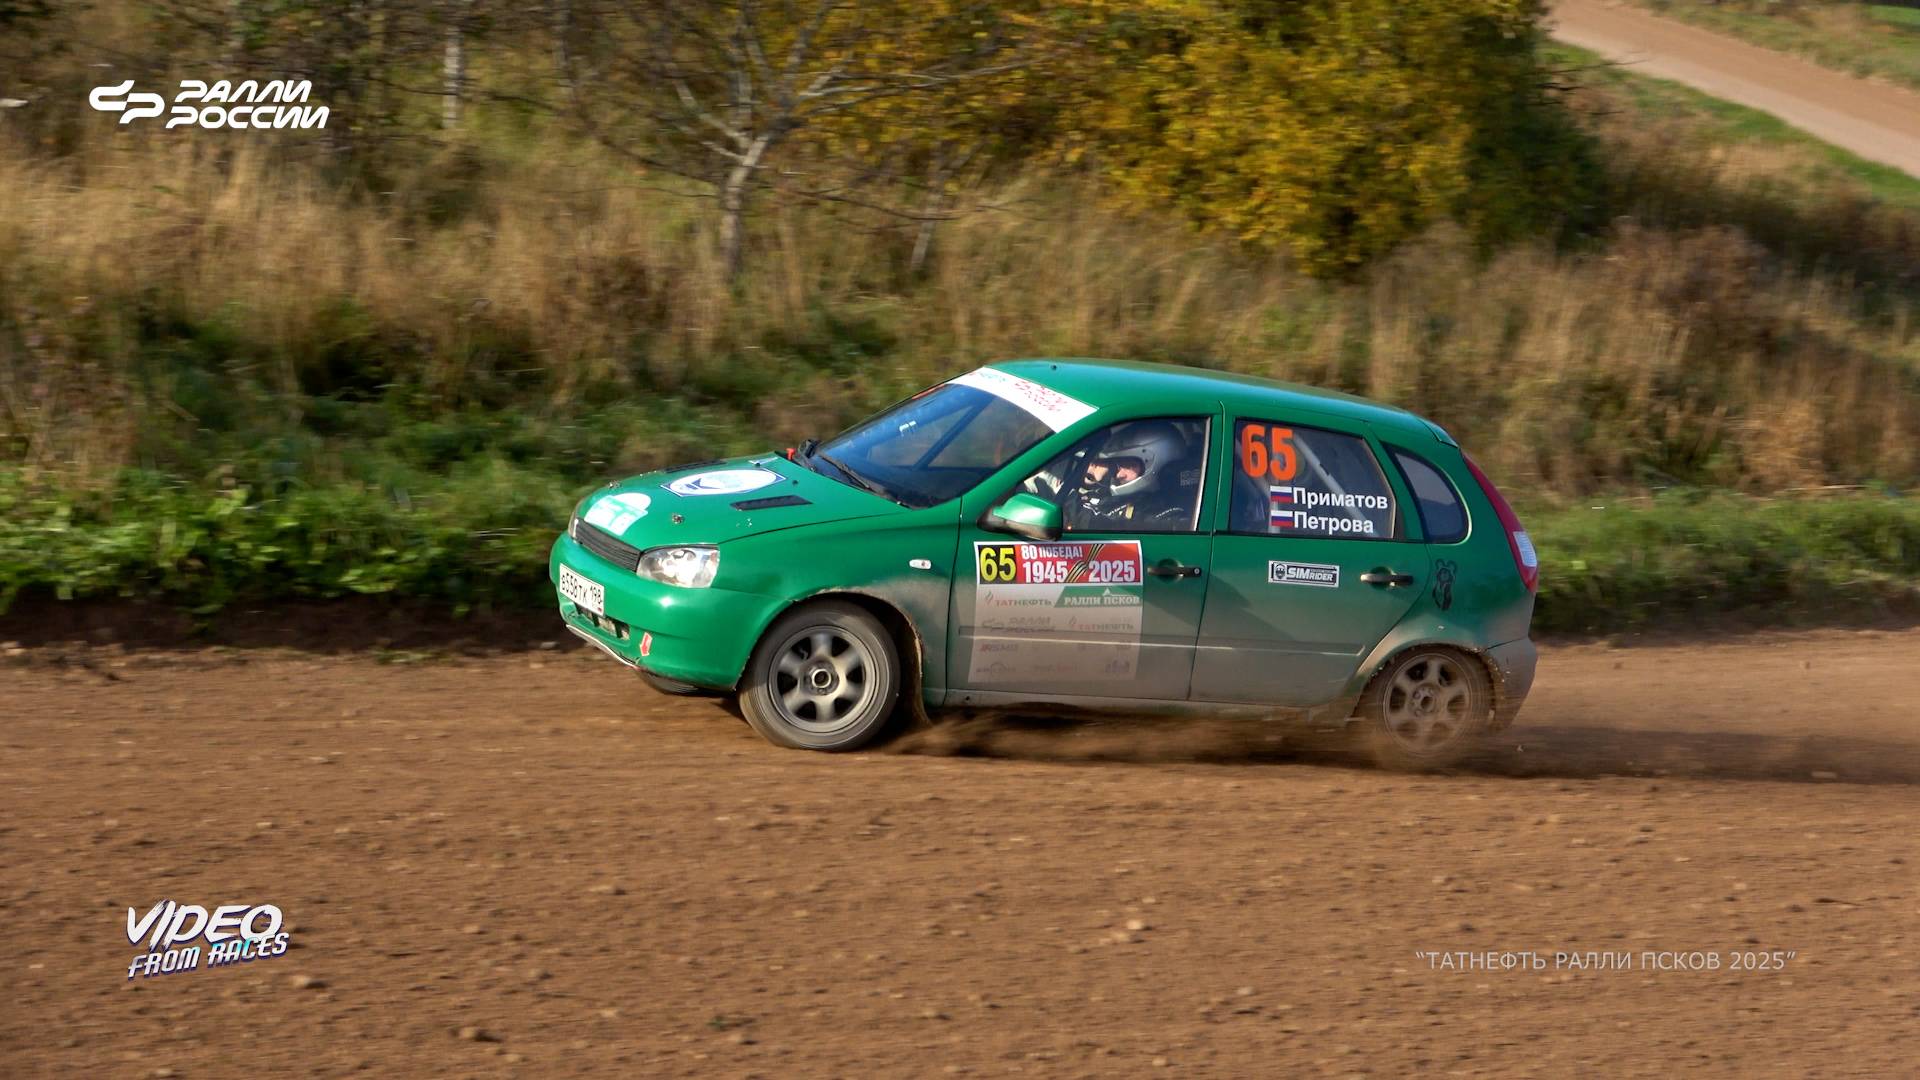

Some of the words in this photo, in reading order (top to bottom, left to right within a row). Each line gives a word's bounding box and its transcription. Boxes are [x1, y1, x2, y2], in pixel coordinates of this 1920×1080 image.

[1241, 424, 1297, 481] 65
[1293, 487, 1388, 510] Приматов
[1293, 511, 1374, 535] Петрова
[979, 546, 1017, 582] 65
[1021, 545, 1038, 560] 80
[1039, 546, 1083, 560] ПОБЕДА!
[1022, 561, 1068, 583] 1945
[1088, 560, 1136, 583] 2025
[995, 598, 1053, 607] ТАТНЕФТЬ
[1064, 596, 1102, 605] РАЛЛИ
[1103, 595, 1140, 605] ПСКОВ
